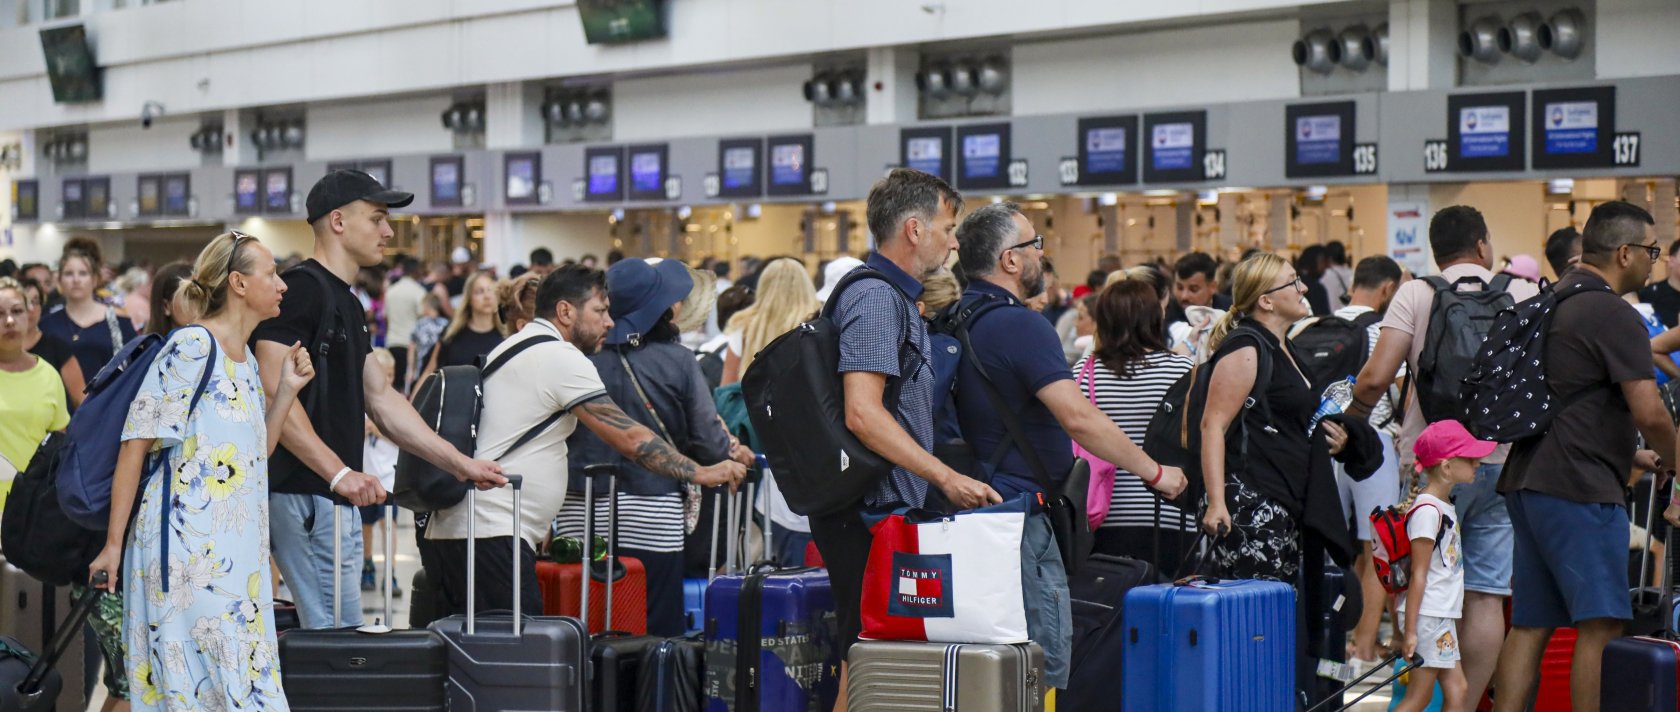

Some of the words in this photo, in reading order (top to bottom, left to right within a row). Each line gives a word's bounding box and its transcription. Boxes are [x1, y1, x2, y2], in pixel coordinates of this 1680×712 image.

[1354, 145, 1376, 172] 135
[1425, 142, 1448, 170] 136
[1613, 135, 1638, 164] 137
[1008, 161, 1028, 185] 132
[1059, 159, 1079, 184] 133
[1203, 151, 1225, 178] 134
[901, 569, 937, 579] TOMMY
[902, 595, 937, 605] HILFIGER
